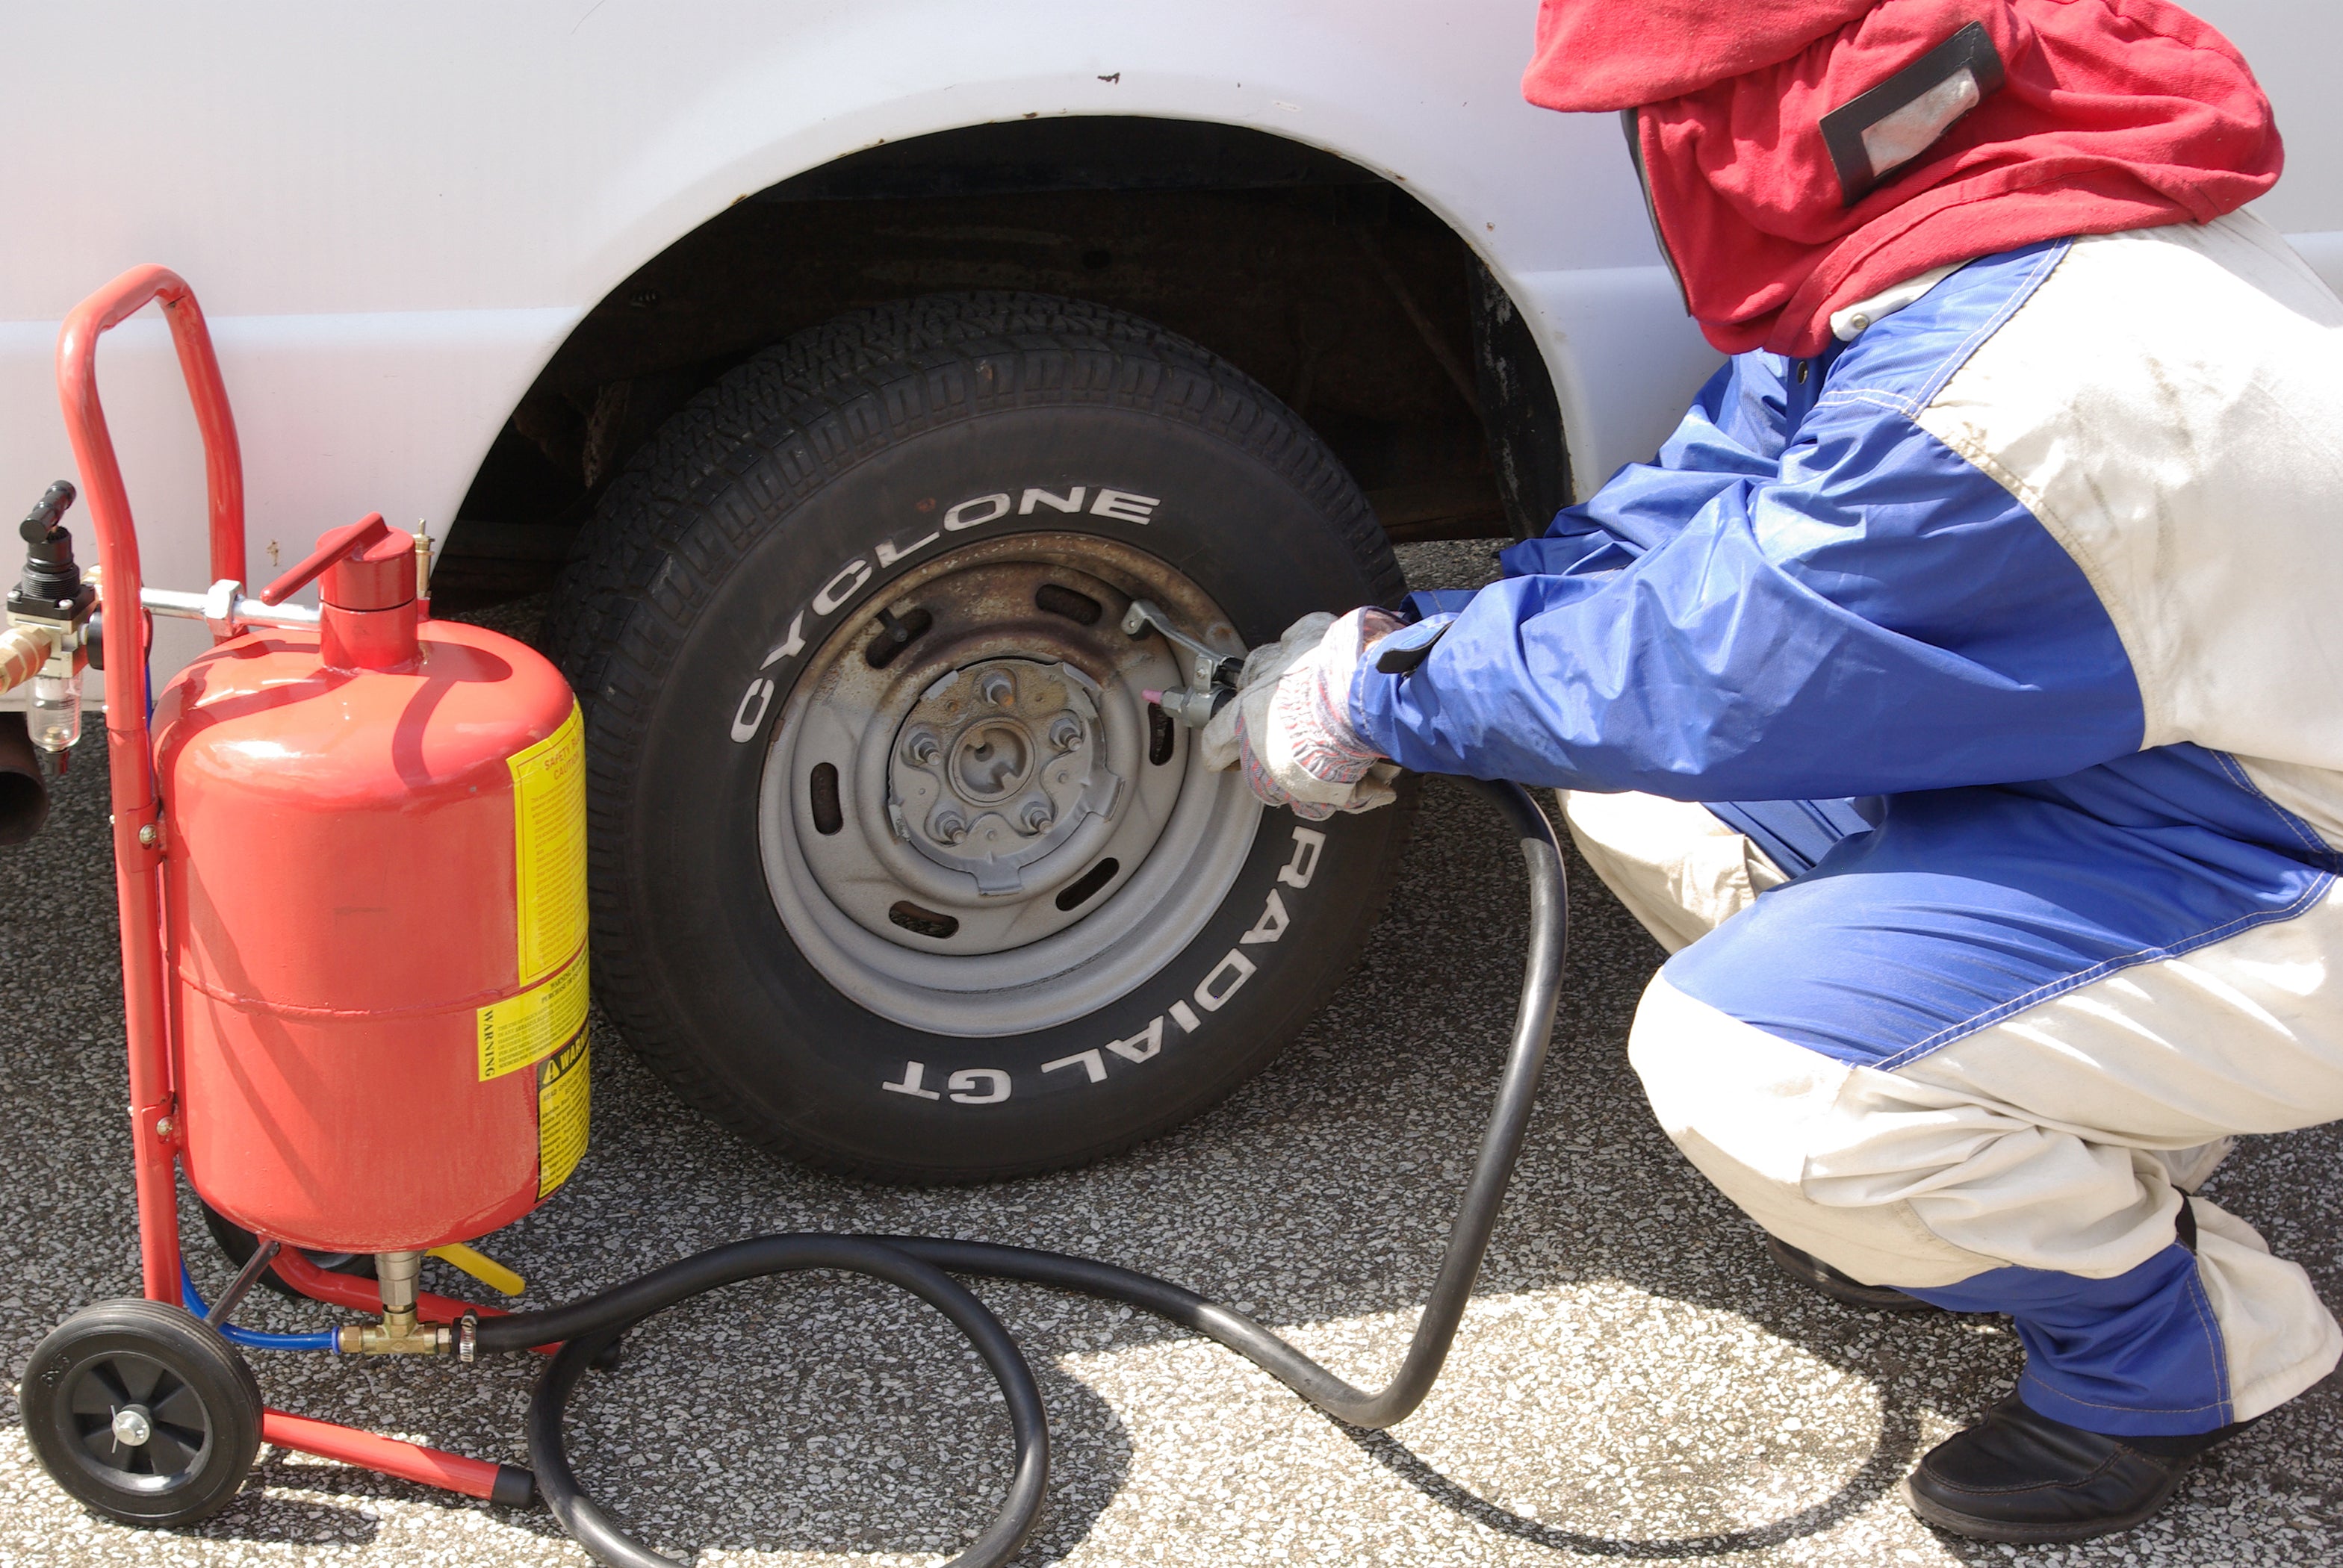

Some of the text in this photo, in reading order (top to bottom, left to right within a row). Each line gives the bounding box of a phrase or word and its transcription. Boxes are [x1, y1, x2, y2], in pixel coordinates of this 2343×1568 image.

[730, 486, 1161, 743] CYCLONE
[544, 744, 570, 771] SAFETY
[553, 751, 580, 780] CAUTION
[882, 826, 1325, 1104] RADIAL GT
[483, 1009, 495, 1077] WARNING
